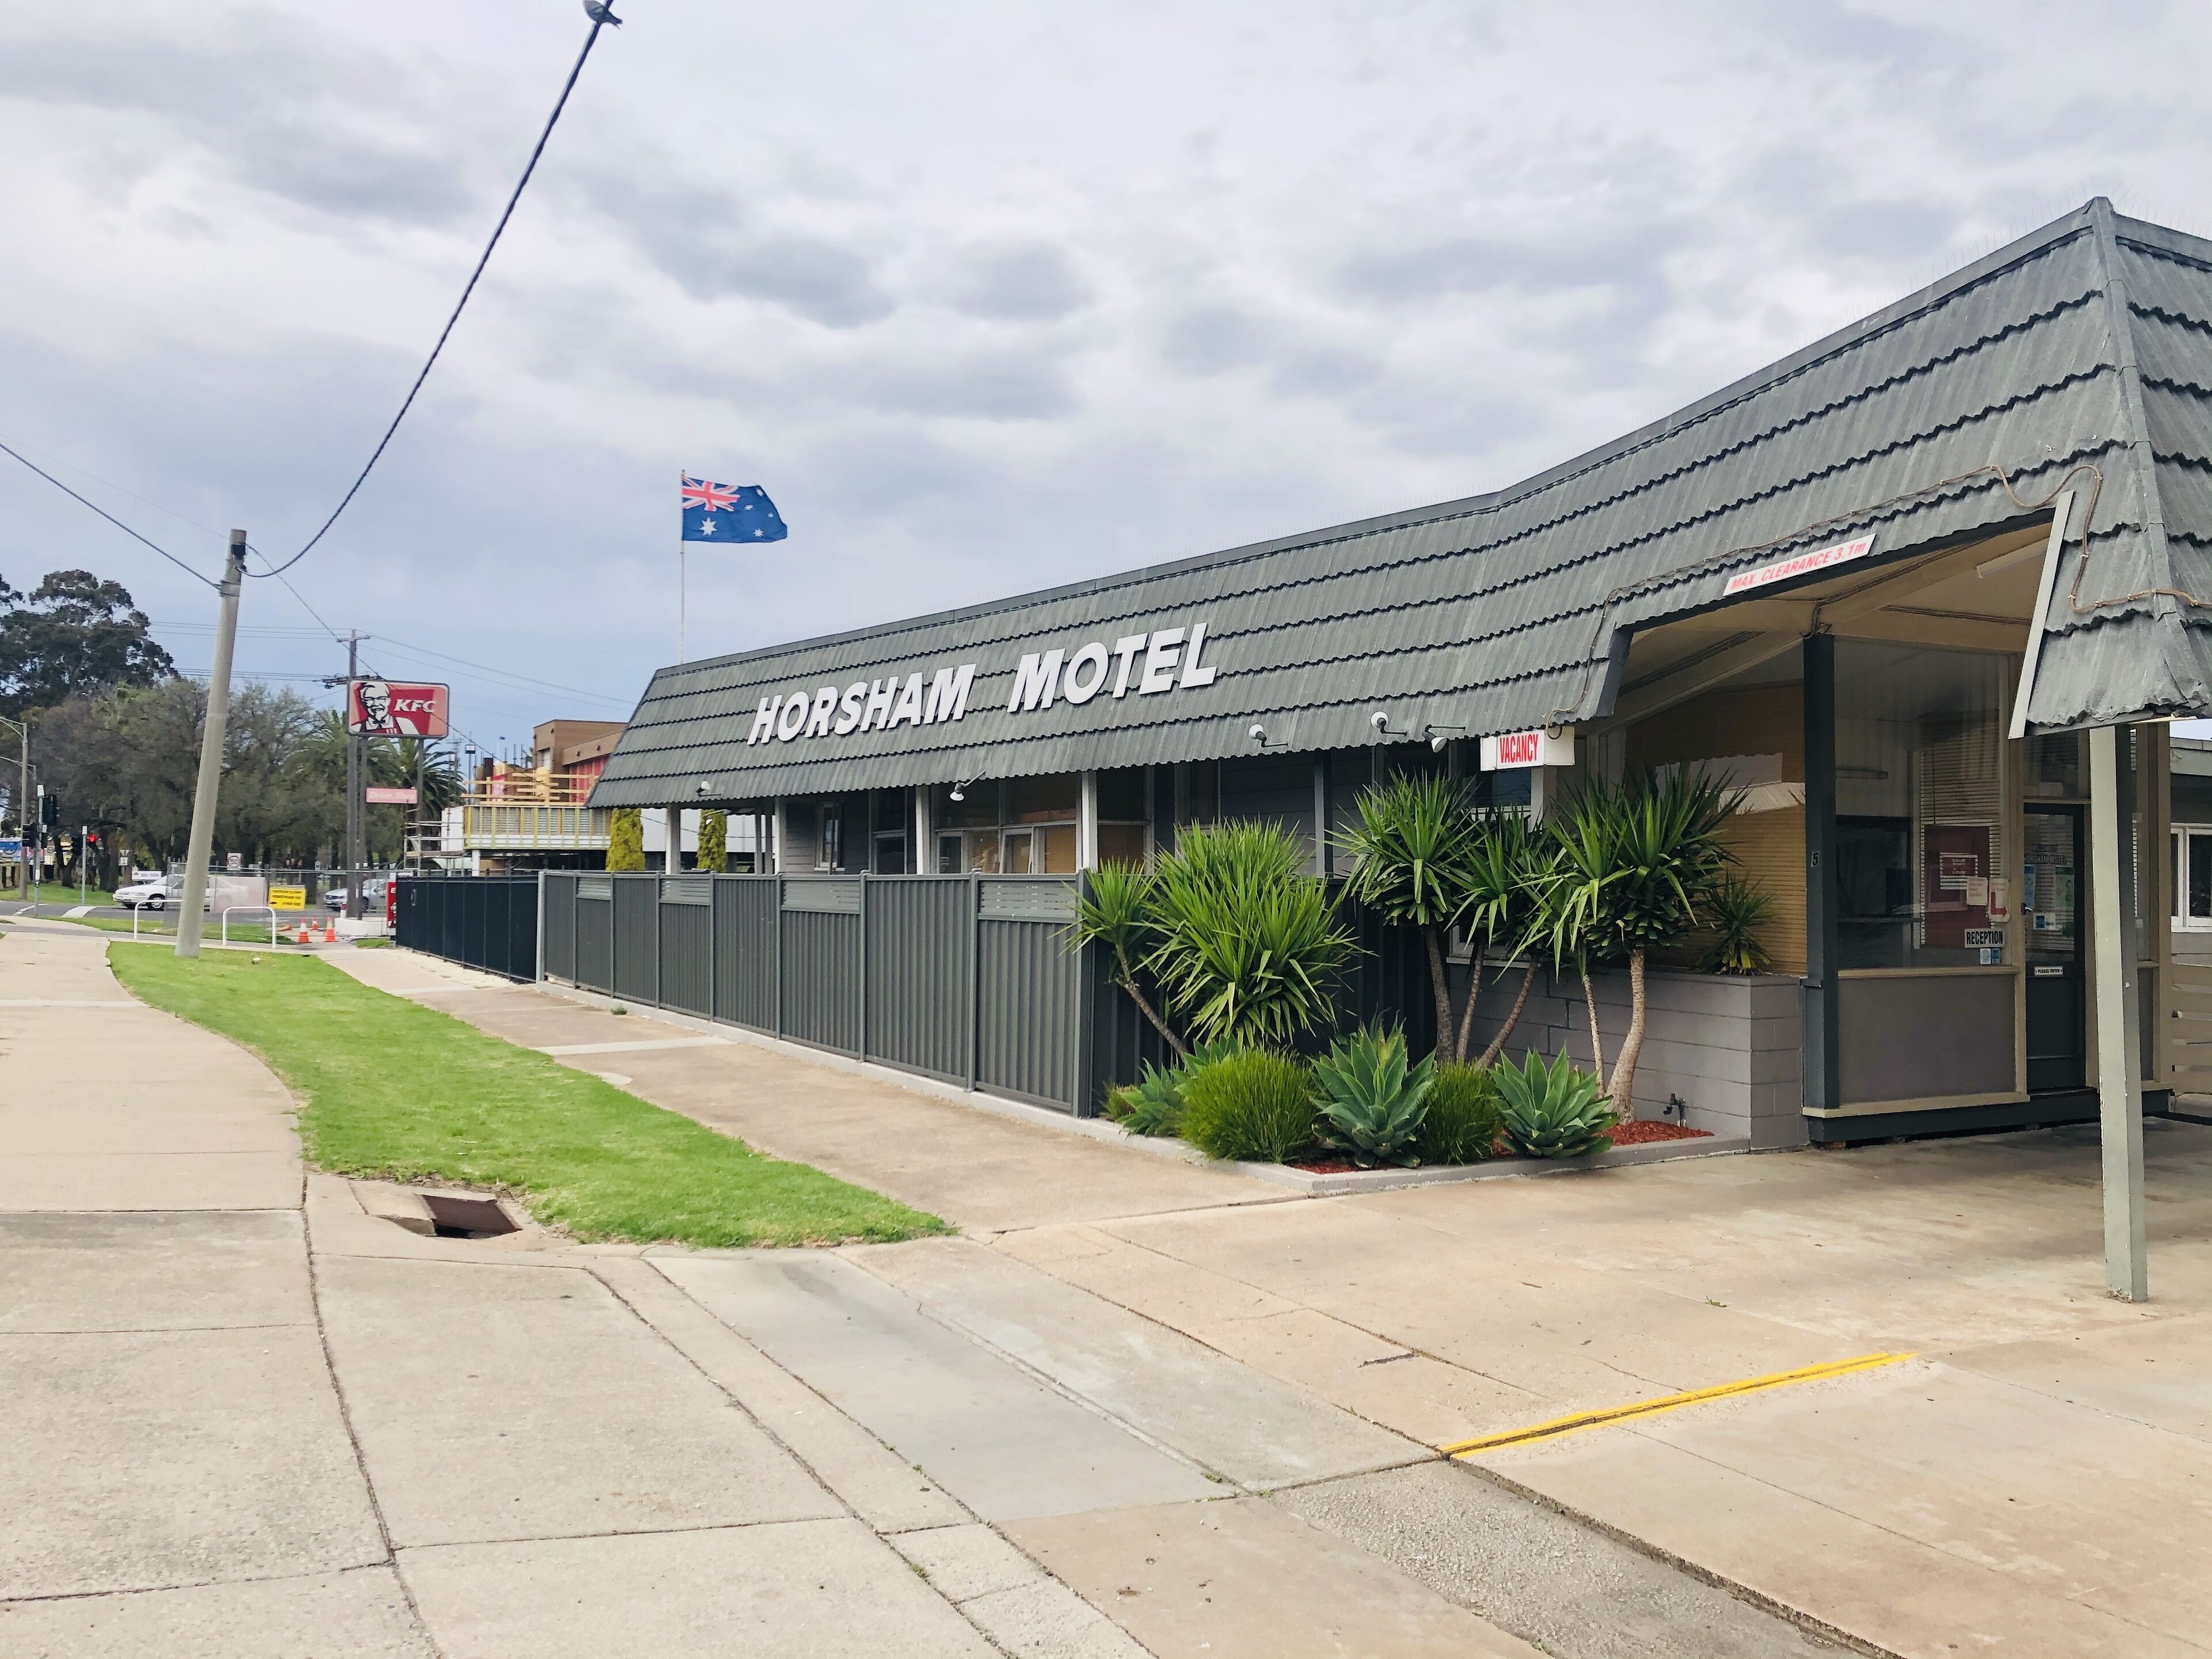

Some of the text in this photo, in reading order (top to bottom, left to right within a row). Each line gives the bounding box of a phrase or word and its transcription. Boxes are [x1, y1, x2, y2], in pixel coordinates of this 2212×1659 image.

[1730, 574, 1756, 590] MAX.
[1761, 551, 1832, 582] CLEARANCE
[747, 622, 1218, 745] HORSHAM MOTEL
[393, 699, 436, 713] KFC
[1499, 734, 1539, 763] VACANCY
[1812, 852, 1819, 866] 5
[1966, 931, 2003, 945] RECEPTION
